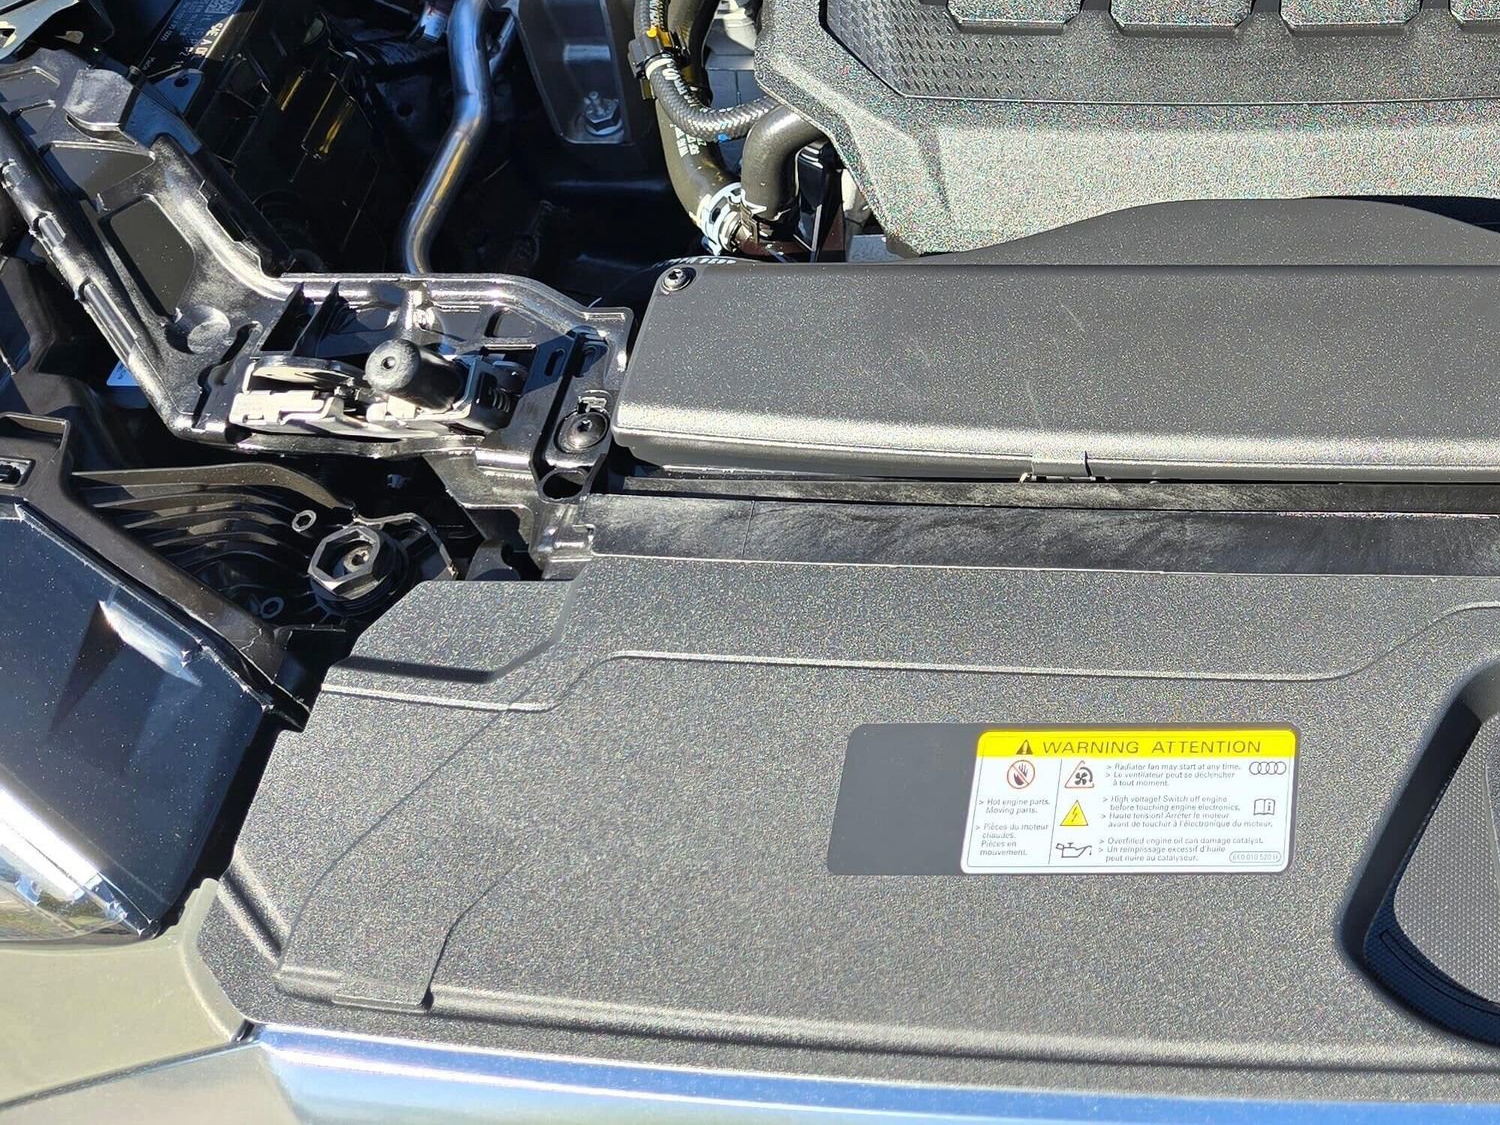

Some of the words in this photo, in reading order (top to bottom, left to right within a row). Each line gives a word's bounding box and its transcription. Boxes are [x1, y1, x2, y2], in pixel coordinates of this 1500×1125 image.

[1042, 741, 1138, 754] WARNING
[1152, 740, 1262, 753] ATTENTION
[1111, 796, 1129, 804] High
[981, 840, 1005, 848] Pièces
